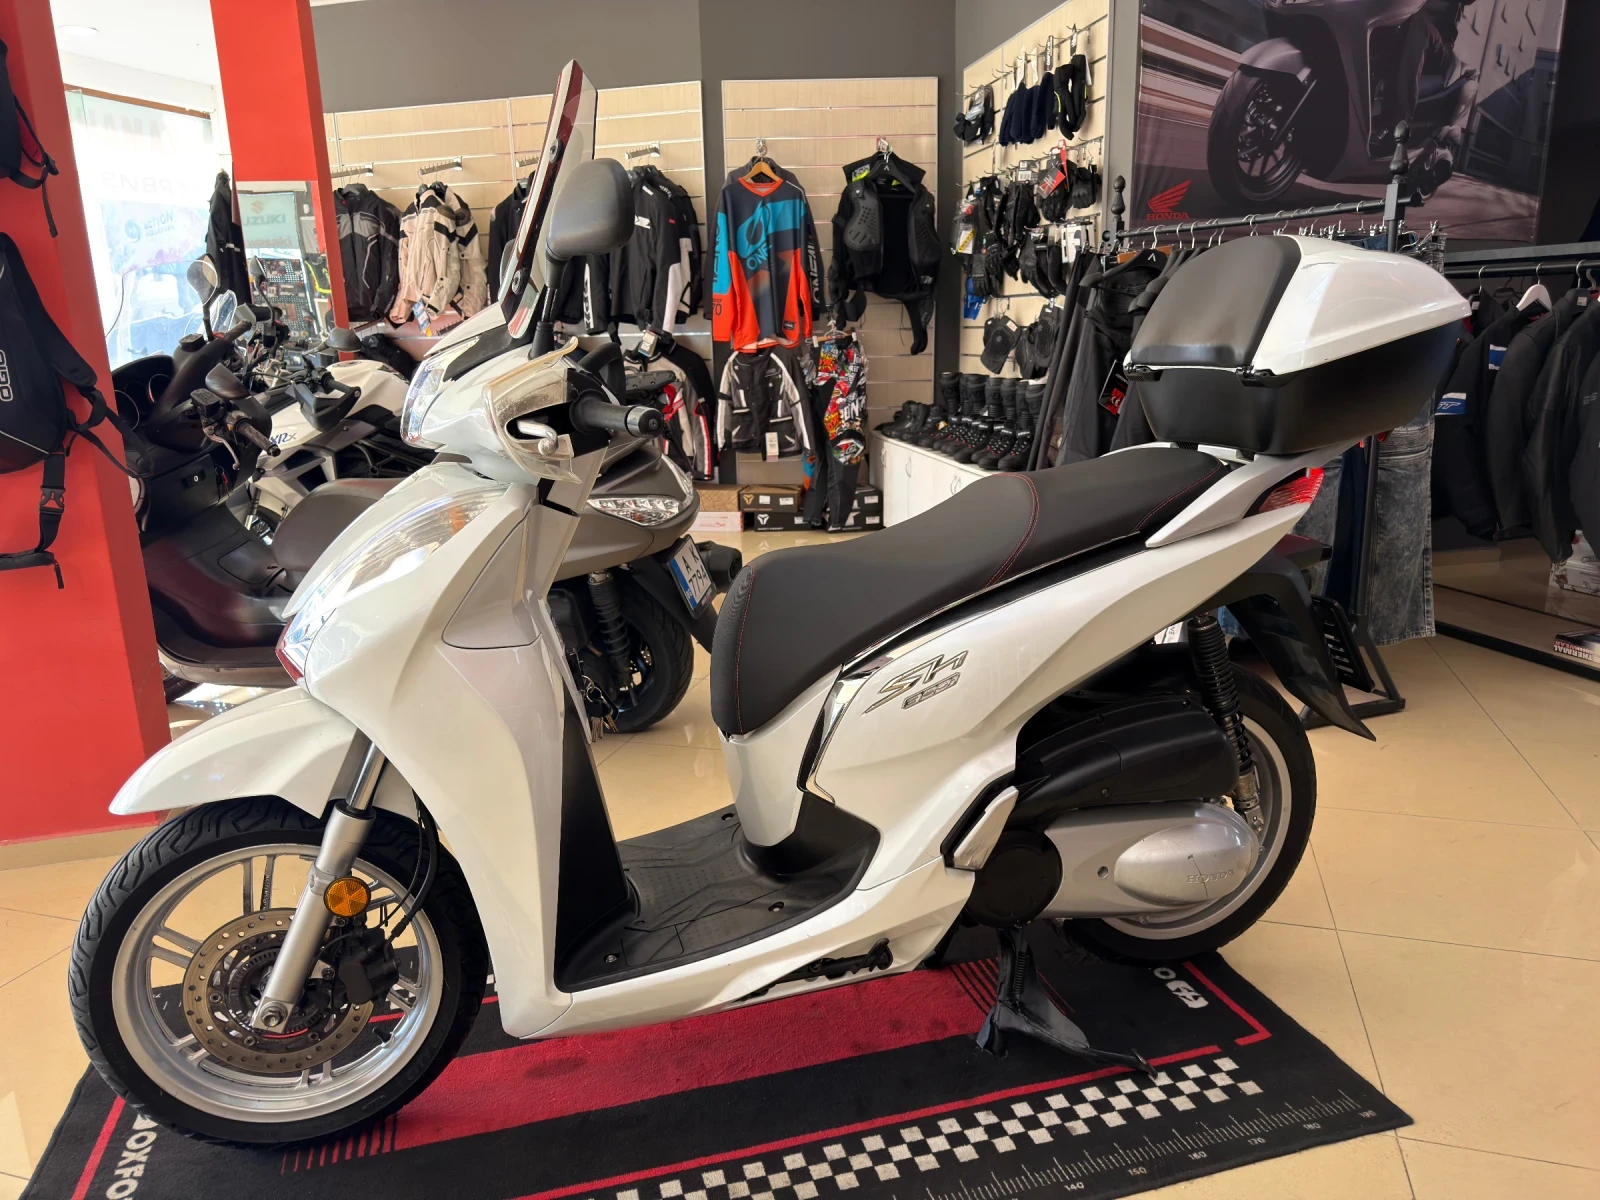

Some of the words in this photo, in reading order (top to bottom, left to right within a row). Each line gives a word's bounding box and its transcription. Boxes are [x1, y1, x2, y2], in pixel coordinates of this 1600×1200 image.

[243, 213, 286, 226] UZUKI
[1146, 212, 1190, 220] HONDA
[681, 555, 692, 574] A
[689, 544, 699, 564] K
[1554, 645, 1593, 661] THERMAL
[861, 650, 969, 717] SH
[1186, 869, 1235, 884] HONDA
[105, 1131, 158, 1200] OXFO
[1063, 1181, 1085, 1192] 140
[1127, 1166, 1147, 1176] 150
[1188, 1151, 1208, 1161] 160
[1247, 1137, 1266, 1146] 170
[1303, 1122, 1322, 1131] 180
